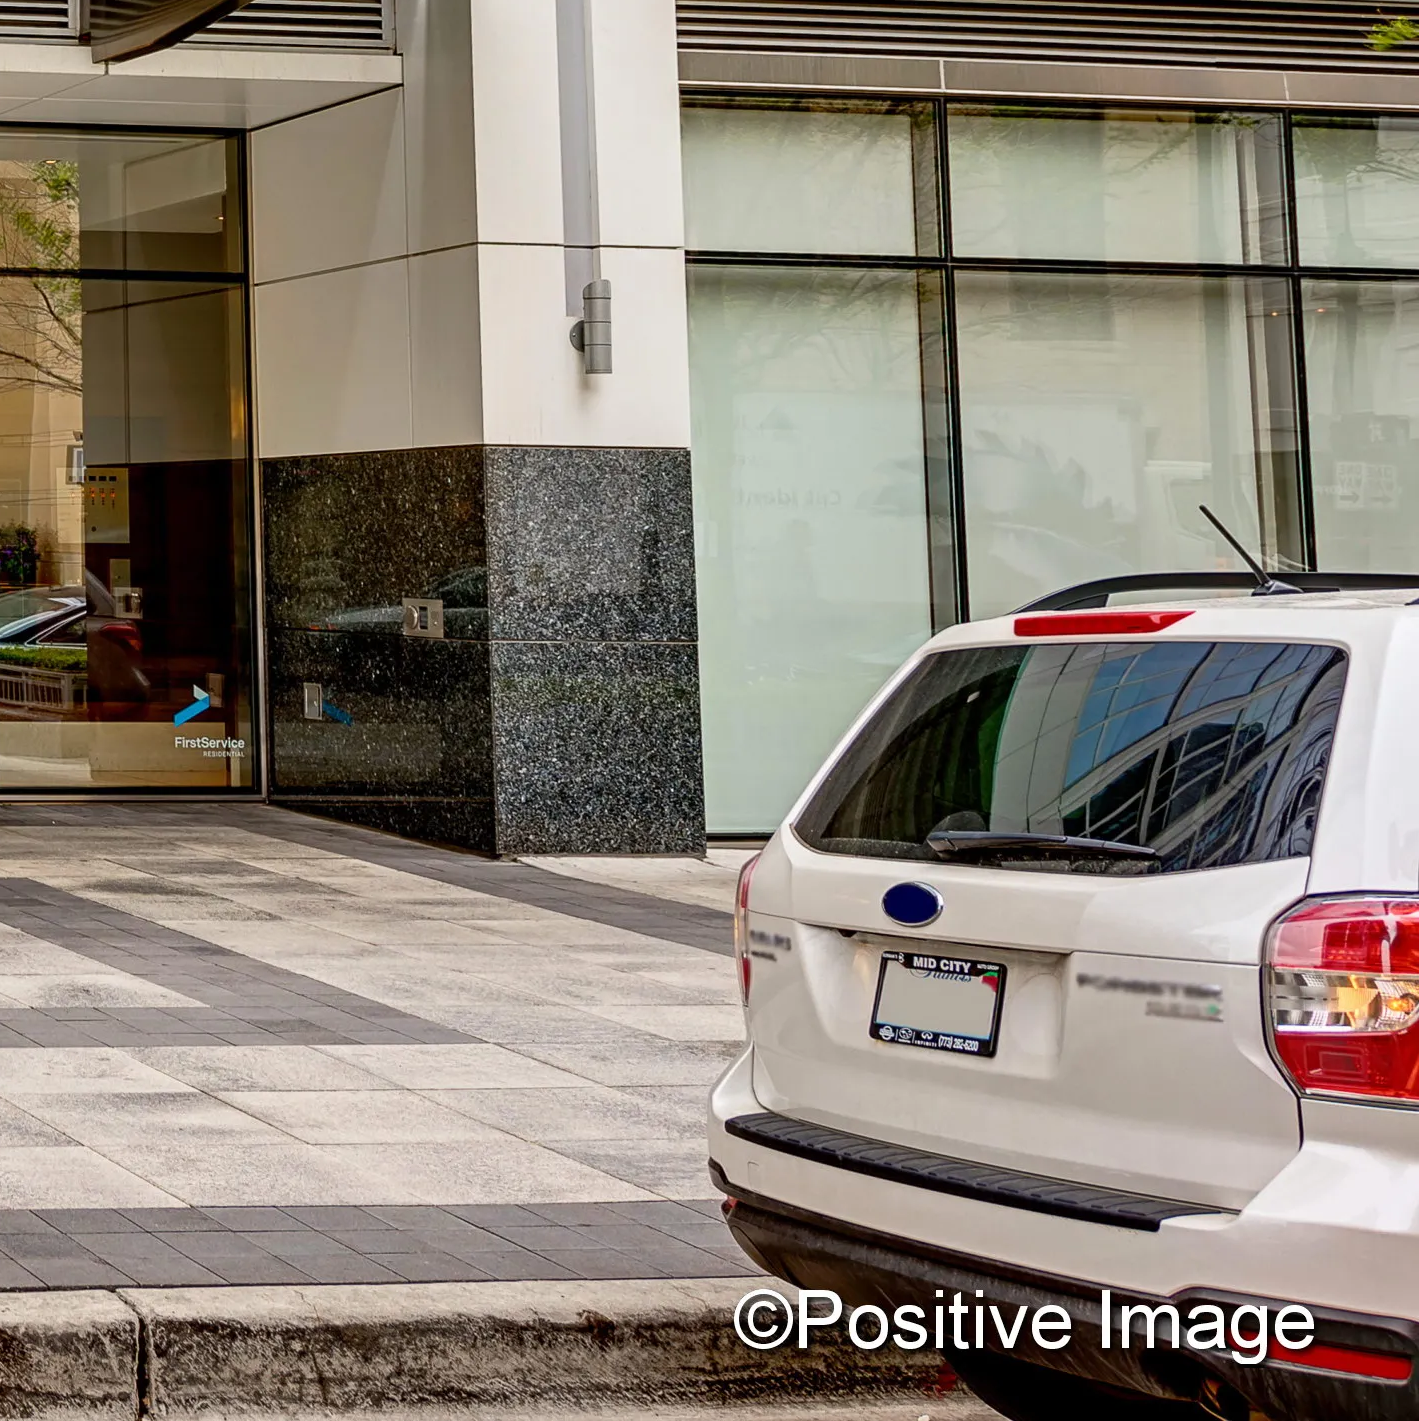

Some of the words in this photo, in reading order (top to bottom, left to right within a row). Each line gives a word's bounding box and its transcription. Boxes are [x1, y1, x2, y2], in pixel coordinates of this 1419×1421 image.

[174, 736, 245, 749] FirstService
[203, 750, 245, 758] RESIDENTIAL
[913, 956, 937, 969] MID
[940, 959, 971, 973] CITY
